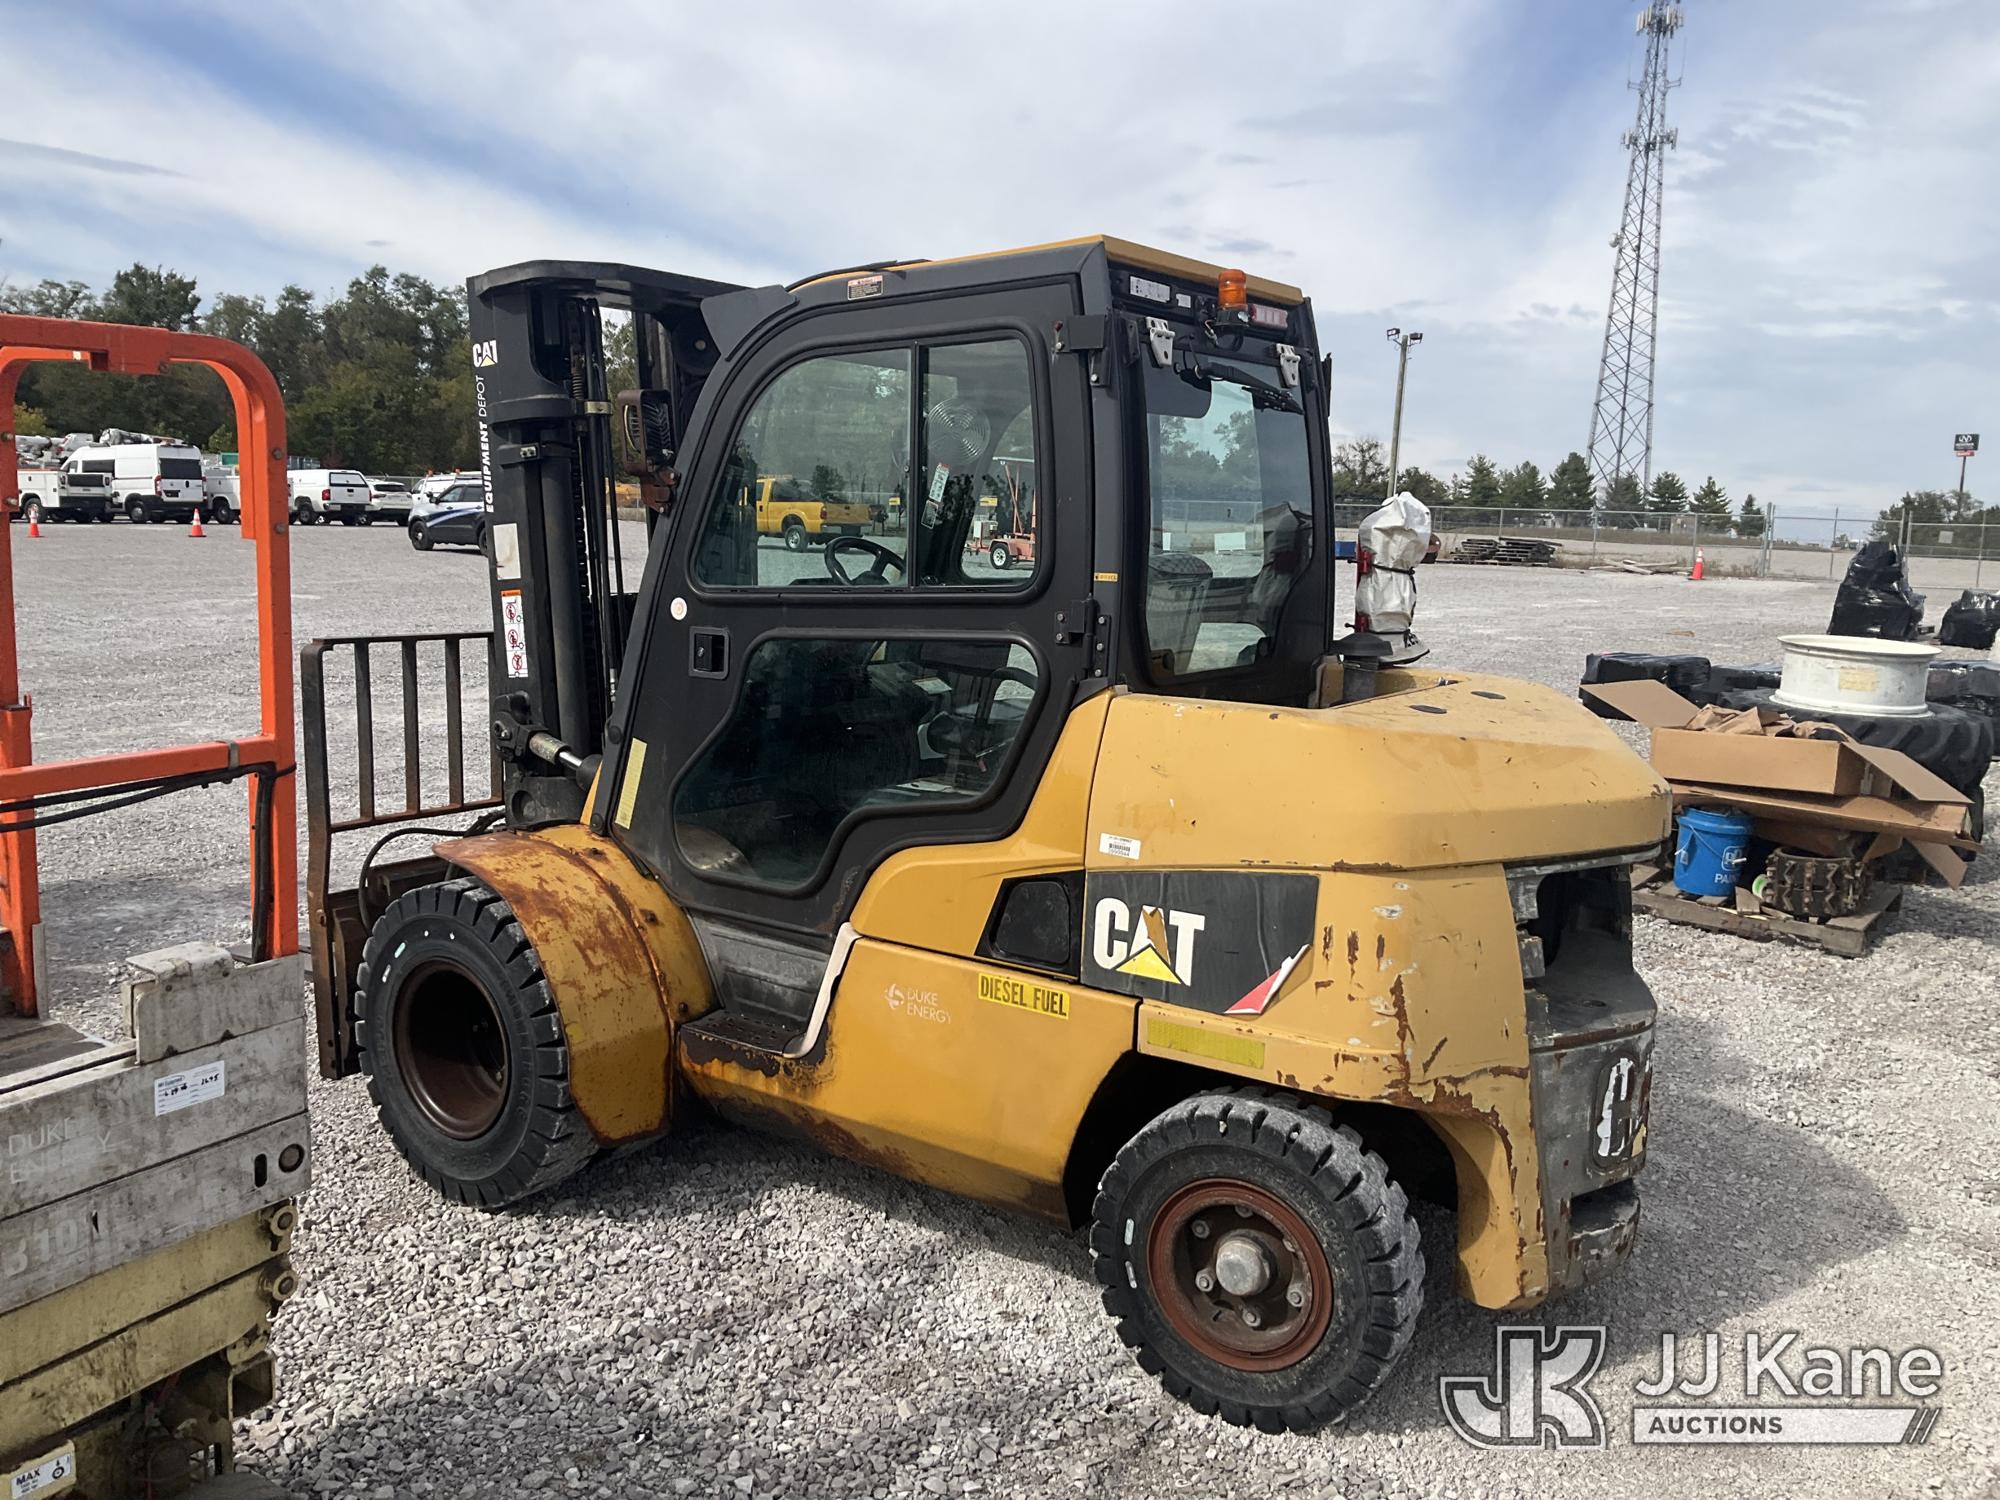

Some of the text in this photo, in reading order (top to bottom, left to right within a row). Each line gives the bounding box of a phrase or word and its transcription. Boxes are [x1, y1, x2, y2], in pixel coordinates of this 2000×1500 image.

[472, 339, 498, 368] CAT
[475, 375, 495, 513] EQUIPMENT DEPOT
[1093, 897, 1206, 987] CAT
[907, 988, 939, 1007] DUKE
[980, 975, 1067, 1017] DIESEL FUEL
[907, 1002, 951, 1025] ENERGY
[16, 1468, 40, 1486] MAX
